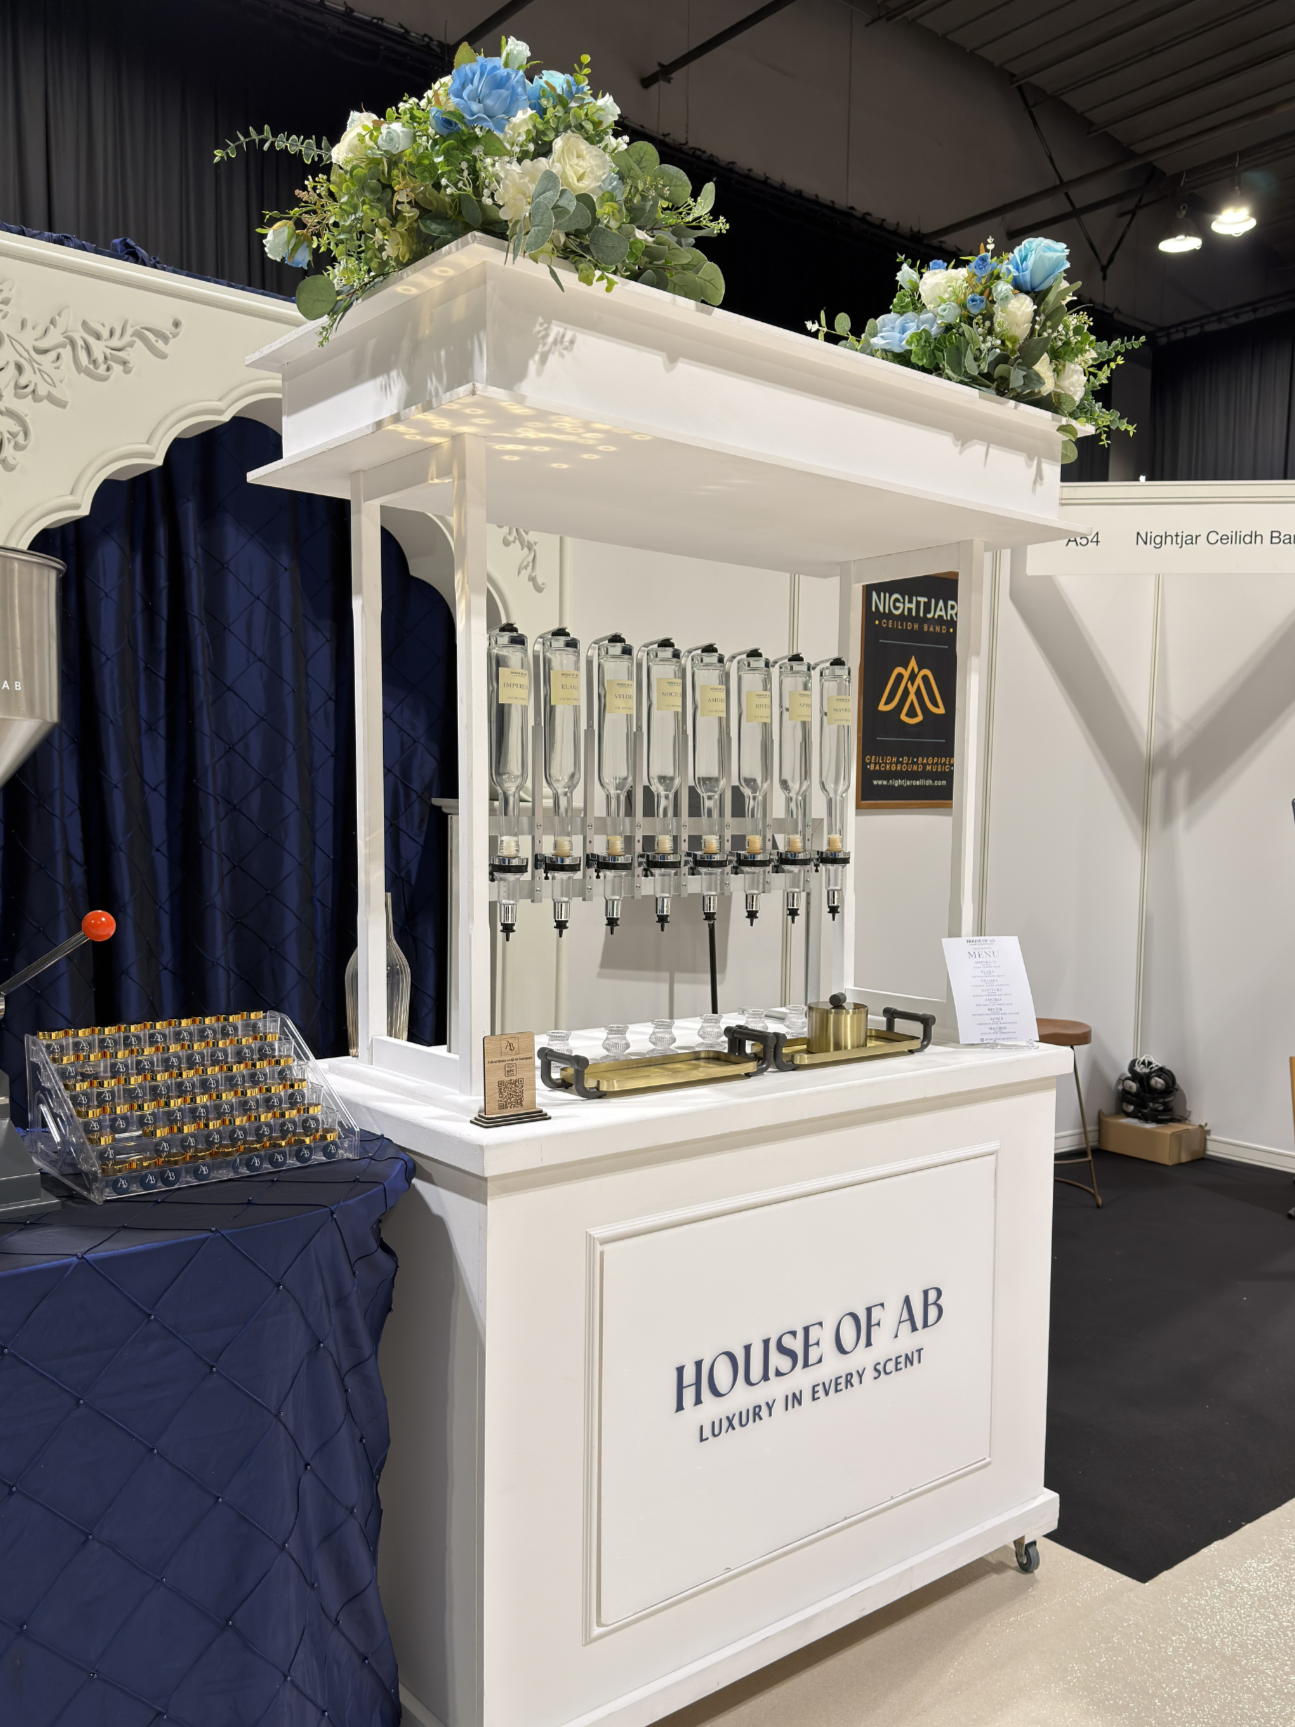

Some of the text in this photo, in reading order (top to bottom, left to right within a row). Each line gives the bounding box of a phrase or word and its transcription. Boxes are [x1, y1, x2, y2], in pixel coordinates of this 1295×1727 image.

[1135, 531, 1201, 549] Nightjar
[1206, 530, 1263, 545] Ceilidh
[871, 590, 958, 621] NIGHTJAR
[881, 619, 947, 633] CEILIDH BAND
[865, 755, 898, 764] CEILIDH
[902, 756, 913, 764] DJ
[869, 763, 950, 772] BACKGROUND MUSIC
[872, 778, 947, 787] www.nightjarceilidh.com
[967, 950, 999, 959] MENU
[204, 1028, 214, 1037] AB
[225, 1025, 235, 1034] AB
[128, 1036, 137, 1045] AB
[154, 1033, 163, 1042] AB
[180, 1031, 190, 1040] AB
[50, 1043, 60, 1052] AB
[80, 1041, 89, 1050] AB
[104, 1038, 114, 1047] AB
[241, 1047, 251, 1057] AB
[262, 1045, 272, 1054] AB
[191, 1053, 202, 1062] AB
[214, 1051, 225, 1060] AB
[140, 1059, 151, 1069] AB
[169, 1056, 179, 1066] AB
[66, 1066, 76, 1076] AB
[115, 1062, 126, 1072] AB
[282, 1067, 291, 1077] AB
[233, 1074, 243, 1084] AB
[255, 1071, 265, 1080] AB
[182, 1081, 192, 1091] AB
[207, 1077, 217, 1087] AB
[134, 1086, 144, 1097] AB
[157, 1084, 167, 1094] AB
[77, 1094, 87, 1104] AB
[101, 1091, 111, 1101] AB
[270, 1096, 280, 1106] AB
[292, 1092, 302, 1101] AB
[221, 1103, 231, 1113] AB
[247, 1100, 257, 1109] AB
[173, 1110, 182, 1120] AB
[196, 1107, 206, 1116] AB
[115, 1118, 126, 1128] AB
[144, 1114, 154, 1124] AB
[306, 1118, 316, 1128] AB
[89, 1121, 100, 1130] AB
[260, 1125, 270, 1135] AB
[284, 1121, 294, 1131] AB
[210, 1132, 220, 1142] AB
[234, 1129, 244, 1139] AB
[160, 1141, 170, 1151] AB
[186, 1136, 196, 1146] AB
[104, 1147, 114, 1158] AB
[300, 1148, 310, 1157] AB
[327, 1143, 336, 1153] AB
[250, 1156, 260, 1166] AB
[273, 1153, 284, 1162] AB
[198, 1164, 209, 1175] AB
[145, 1174, 156, 1184] AB
[164, 1169, 176, 1181] AB
[117, 1178, 128, 1188] AB
[675, 1286, 944, 1413] HOUSE OF AB
[699, 1348, 924, 1443] LUXURY IN EVERY SCENT
